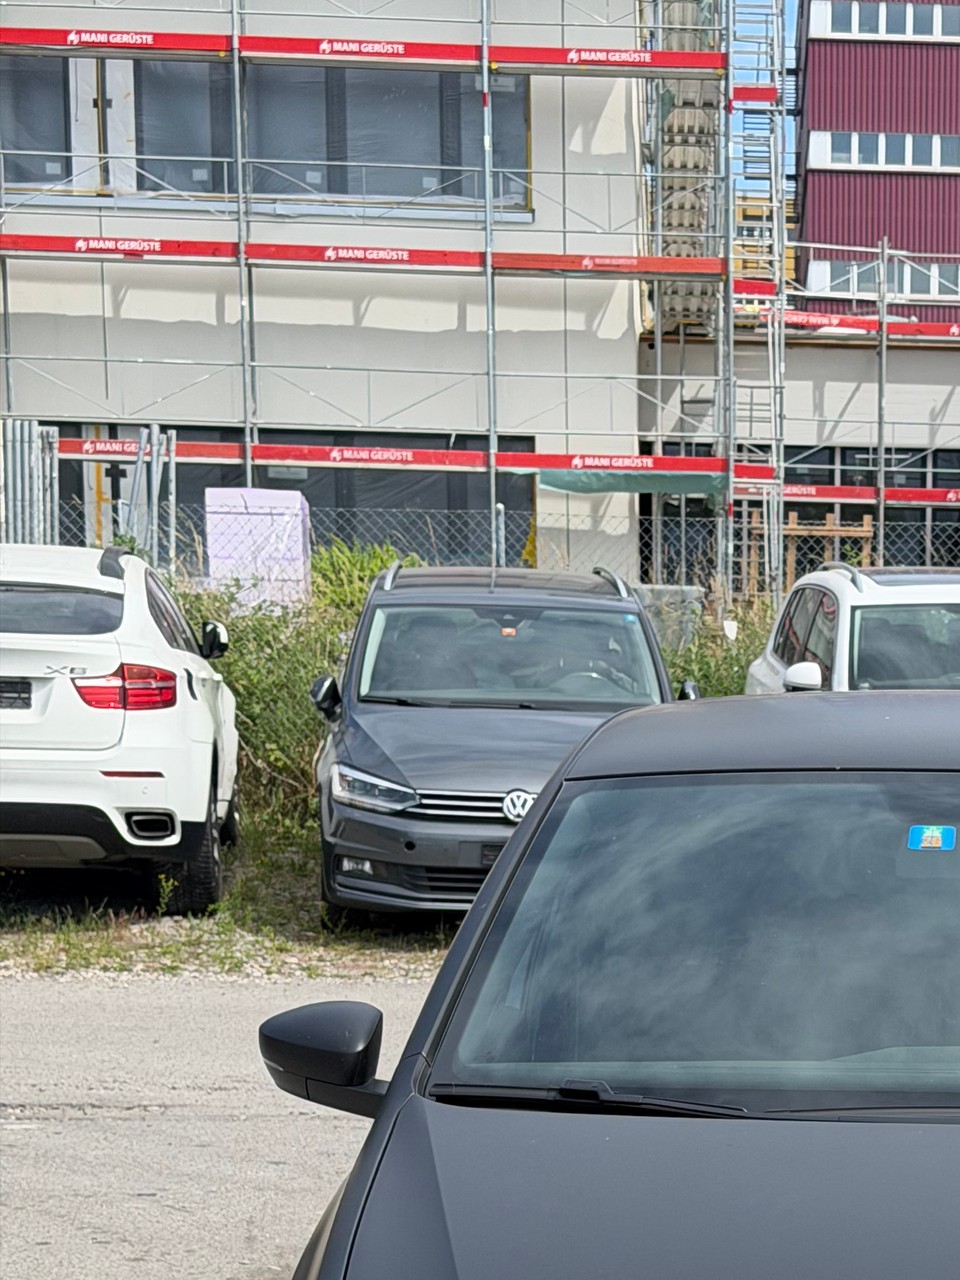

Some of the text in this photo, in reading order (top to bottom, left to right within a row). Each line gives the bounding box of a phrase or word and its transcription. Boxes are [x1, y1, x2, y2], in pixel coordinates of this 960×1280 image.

[80, 32, 154, 45] MANI GERÜSTE
[332, 41, 405, 54] MANI GERÜSTE
[580, 50, 652, 62] MANI GERÜSTE
[88, 239, 162, 251] MANI GERÜSTE
[337, 248, 410, 260] MANI GERÜSTE
[95, 442, 123, 452] MANI
[342, 449, 414, 461] MANI GERÜSTE
[584, 456, 655, 468] MANI GERÜSTE
